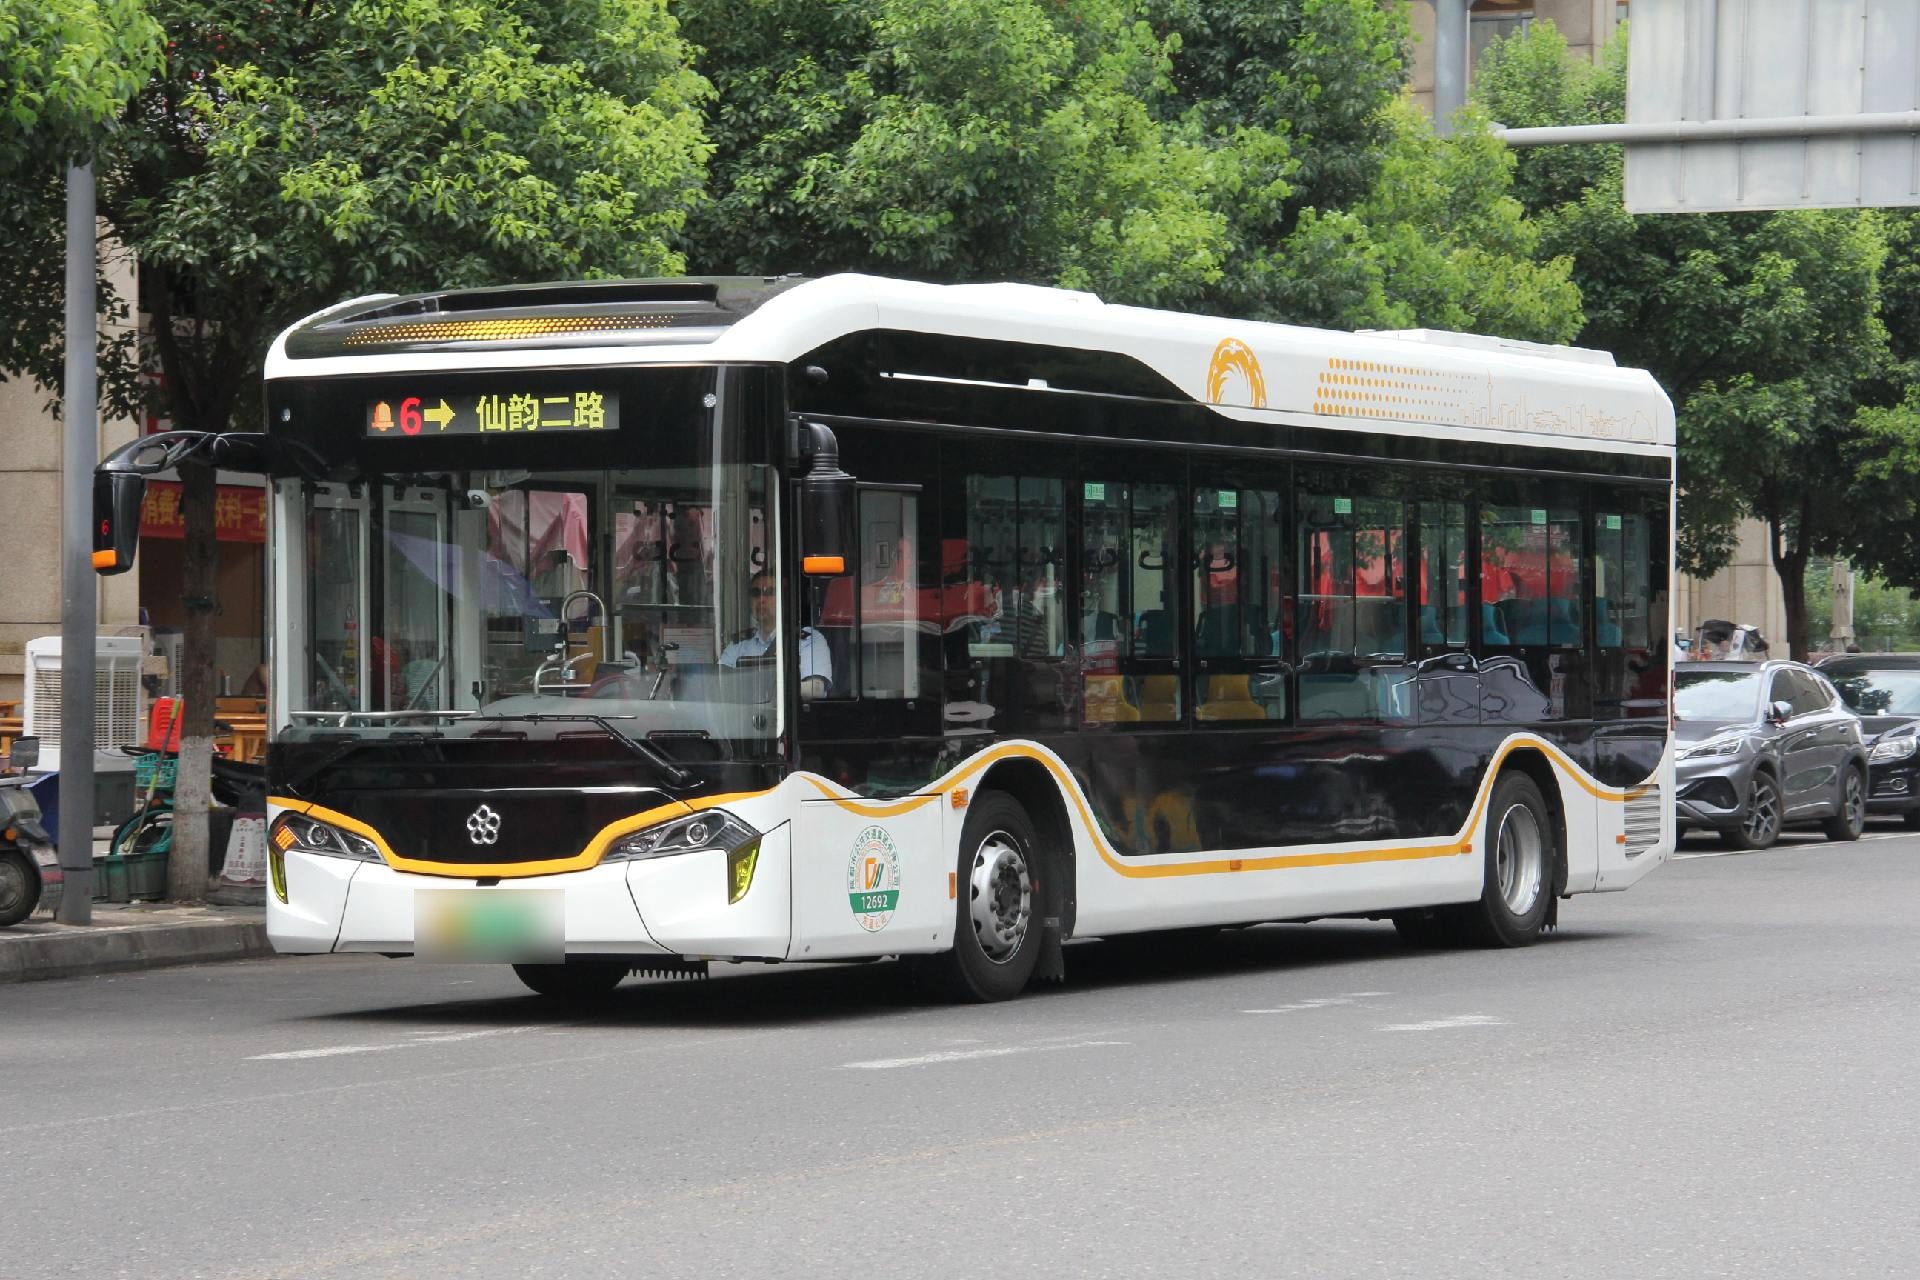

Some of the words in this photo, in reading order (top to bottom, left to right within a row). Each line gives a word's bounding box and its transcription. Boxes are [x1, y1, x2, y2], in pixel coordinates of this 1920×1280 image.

[400, 397, 422, 436] 6
[475, 391, 605, 432] 仙韵二路
[860, 894, 888, 909] 12692
